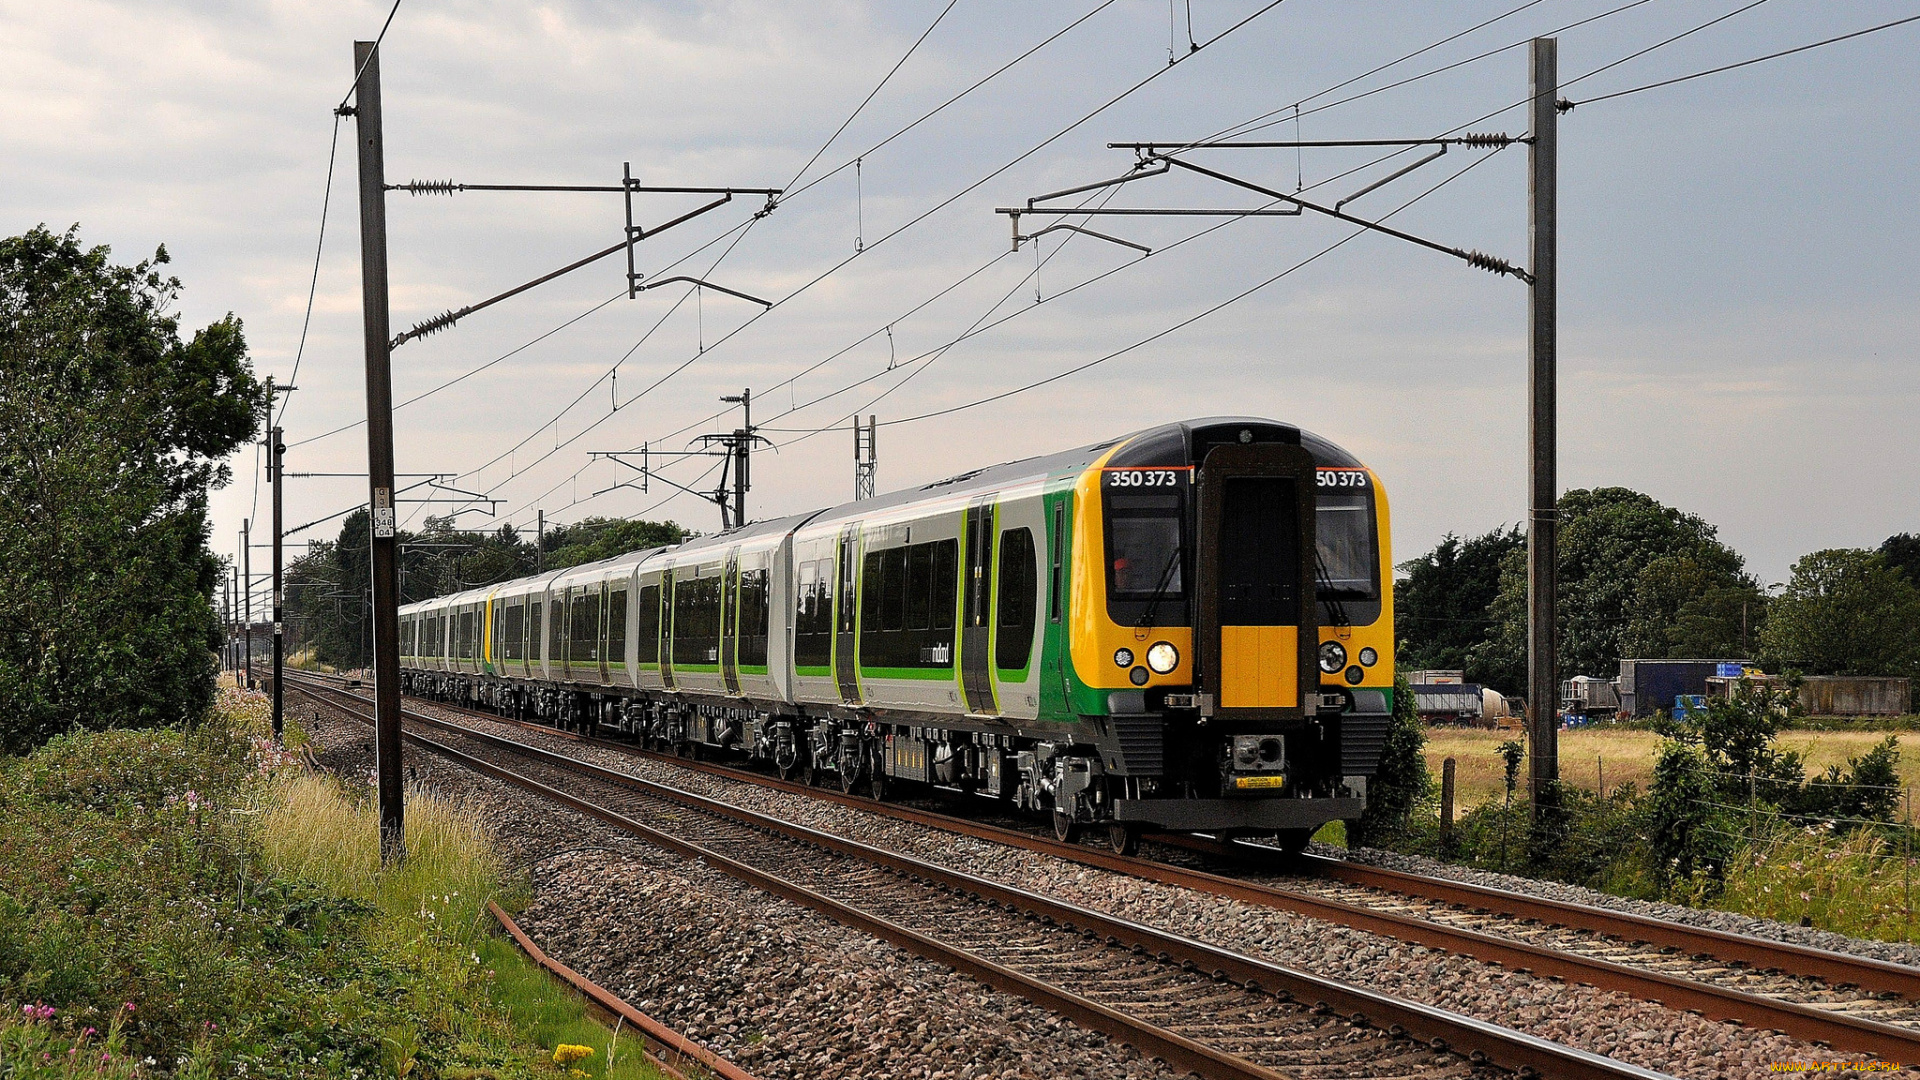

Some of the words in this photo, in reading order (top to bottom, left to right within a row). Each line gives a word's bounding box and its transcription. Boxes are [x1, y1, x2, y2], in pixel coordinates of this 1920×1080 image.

[1110, 471, 1143, 487] 350
[1144, 471, 1177, 487] 373
[1315, 471, 1337, 487] 50
[1338, 471, 1366, 487] 373
[375, 518, 393, 527] 348
